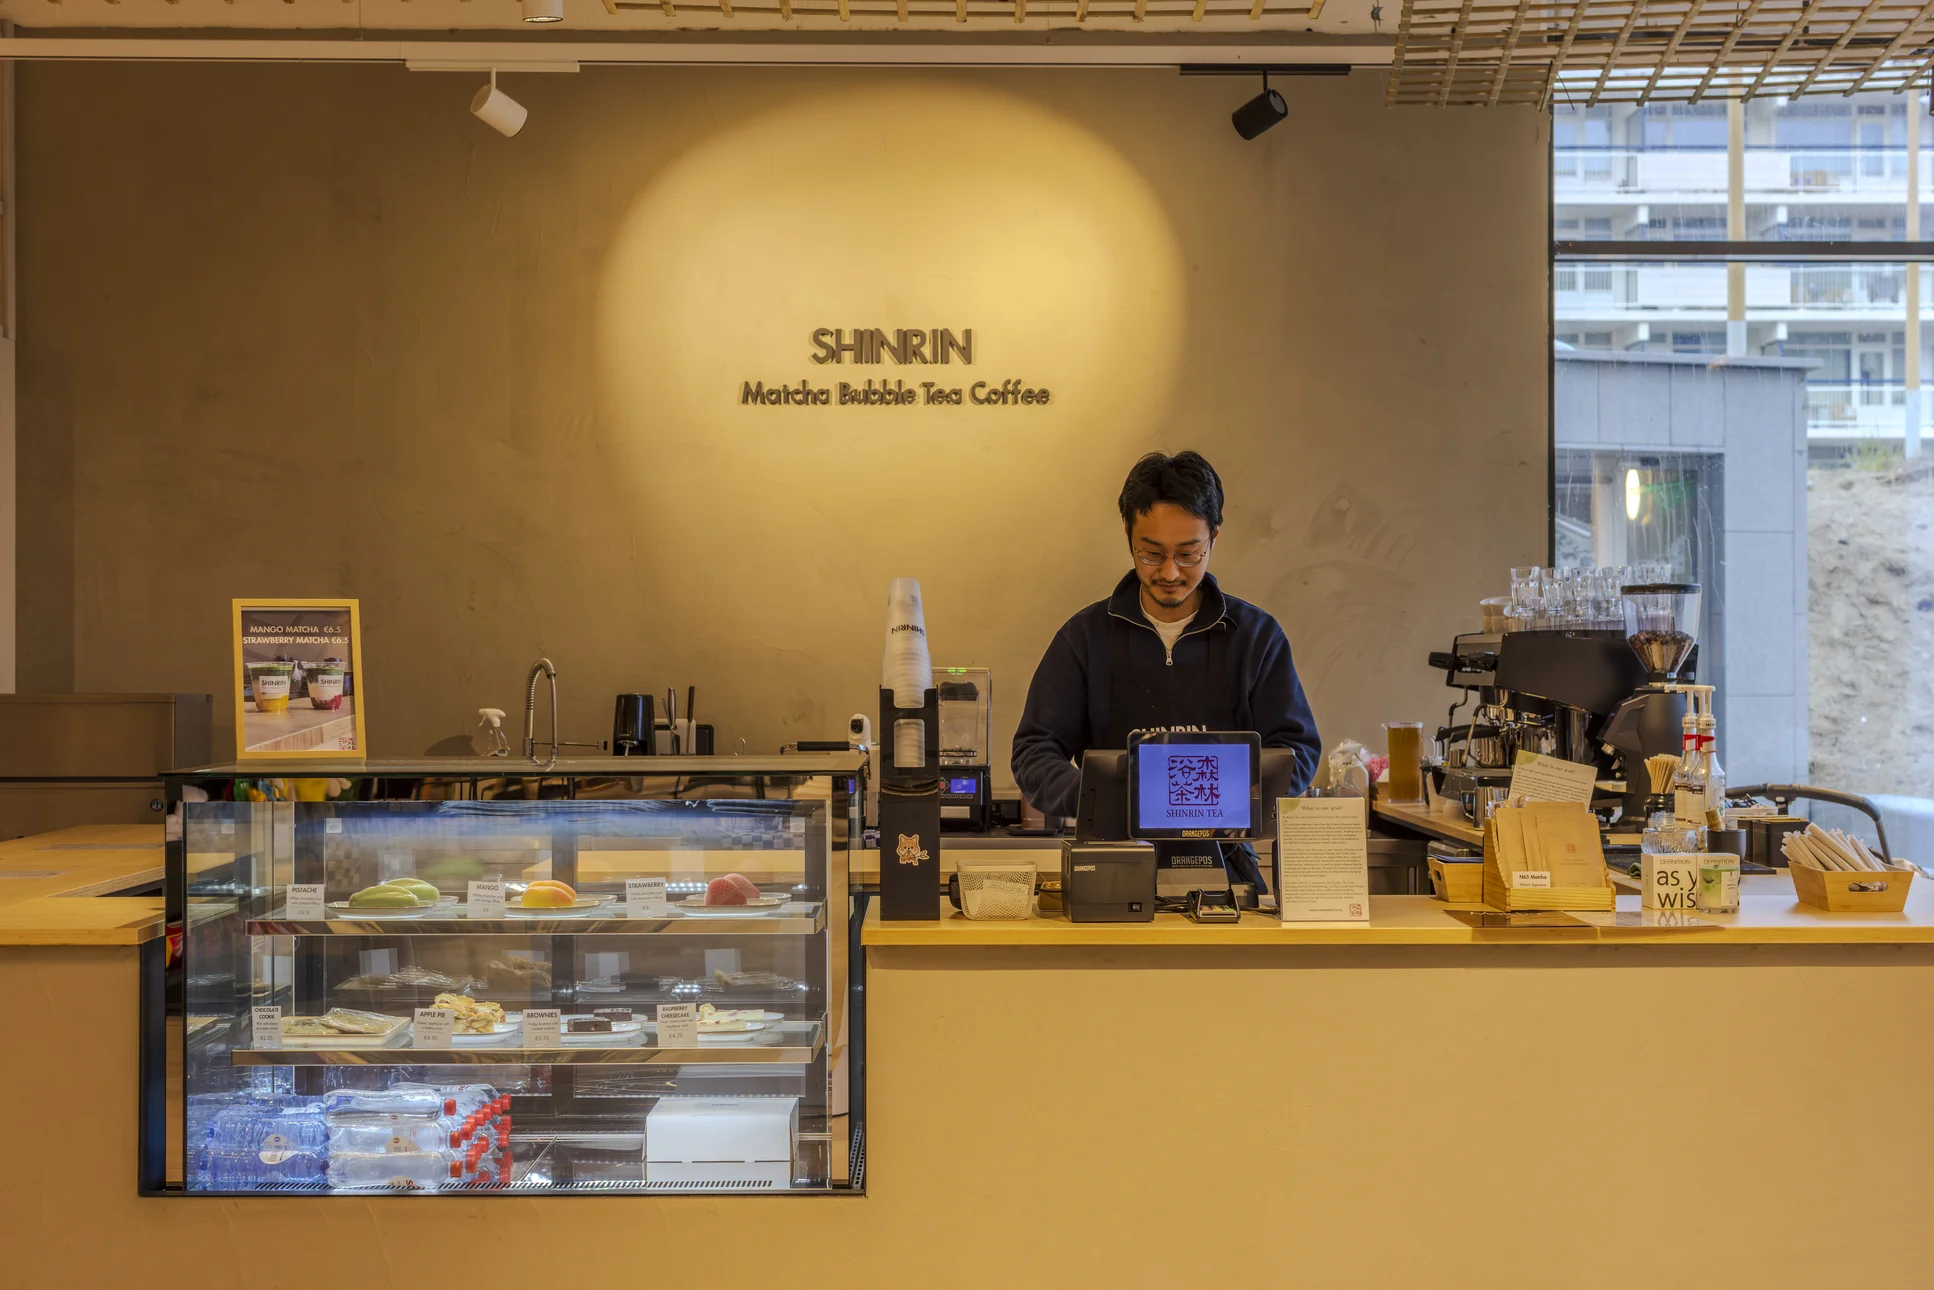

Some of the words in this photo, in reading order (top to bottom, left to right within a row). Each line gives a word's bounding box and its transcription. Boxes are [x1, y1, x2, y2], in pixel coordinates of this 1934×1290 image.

[811, 328, 972, 365] SHINRIN
[742, 379, 830, 405] Matcha
[839, 379, 916, 405] Bubble
[920, 382, 962, 405] Tea
[970, 379, 1050, 405] Coffee
[1166, 809, 1204, 818] SHINRIN
[1206, 809, 1224, 818] TEA
[1171, 856, 1213, 865] ORANGEPOS
[1657, 870, 1680, 886] as
[1657, 887, 1696, 908] wis
